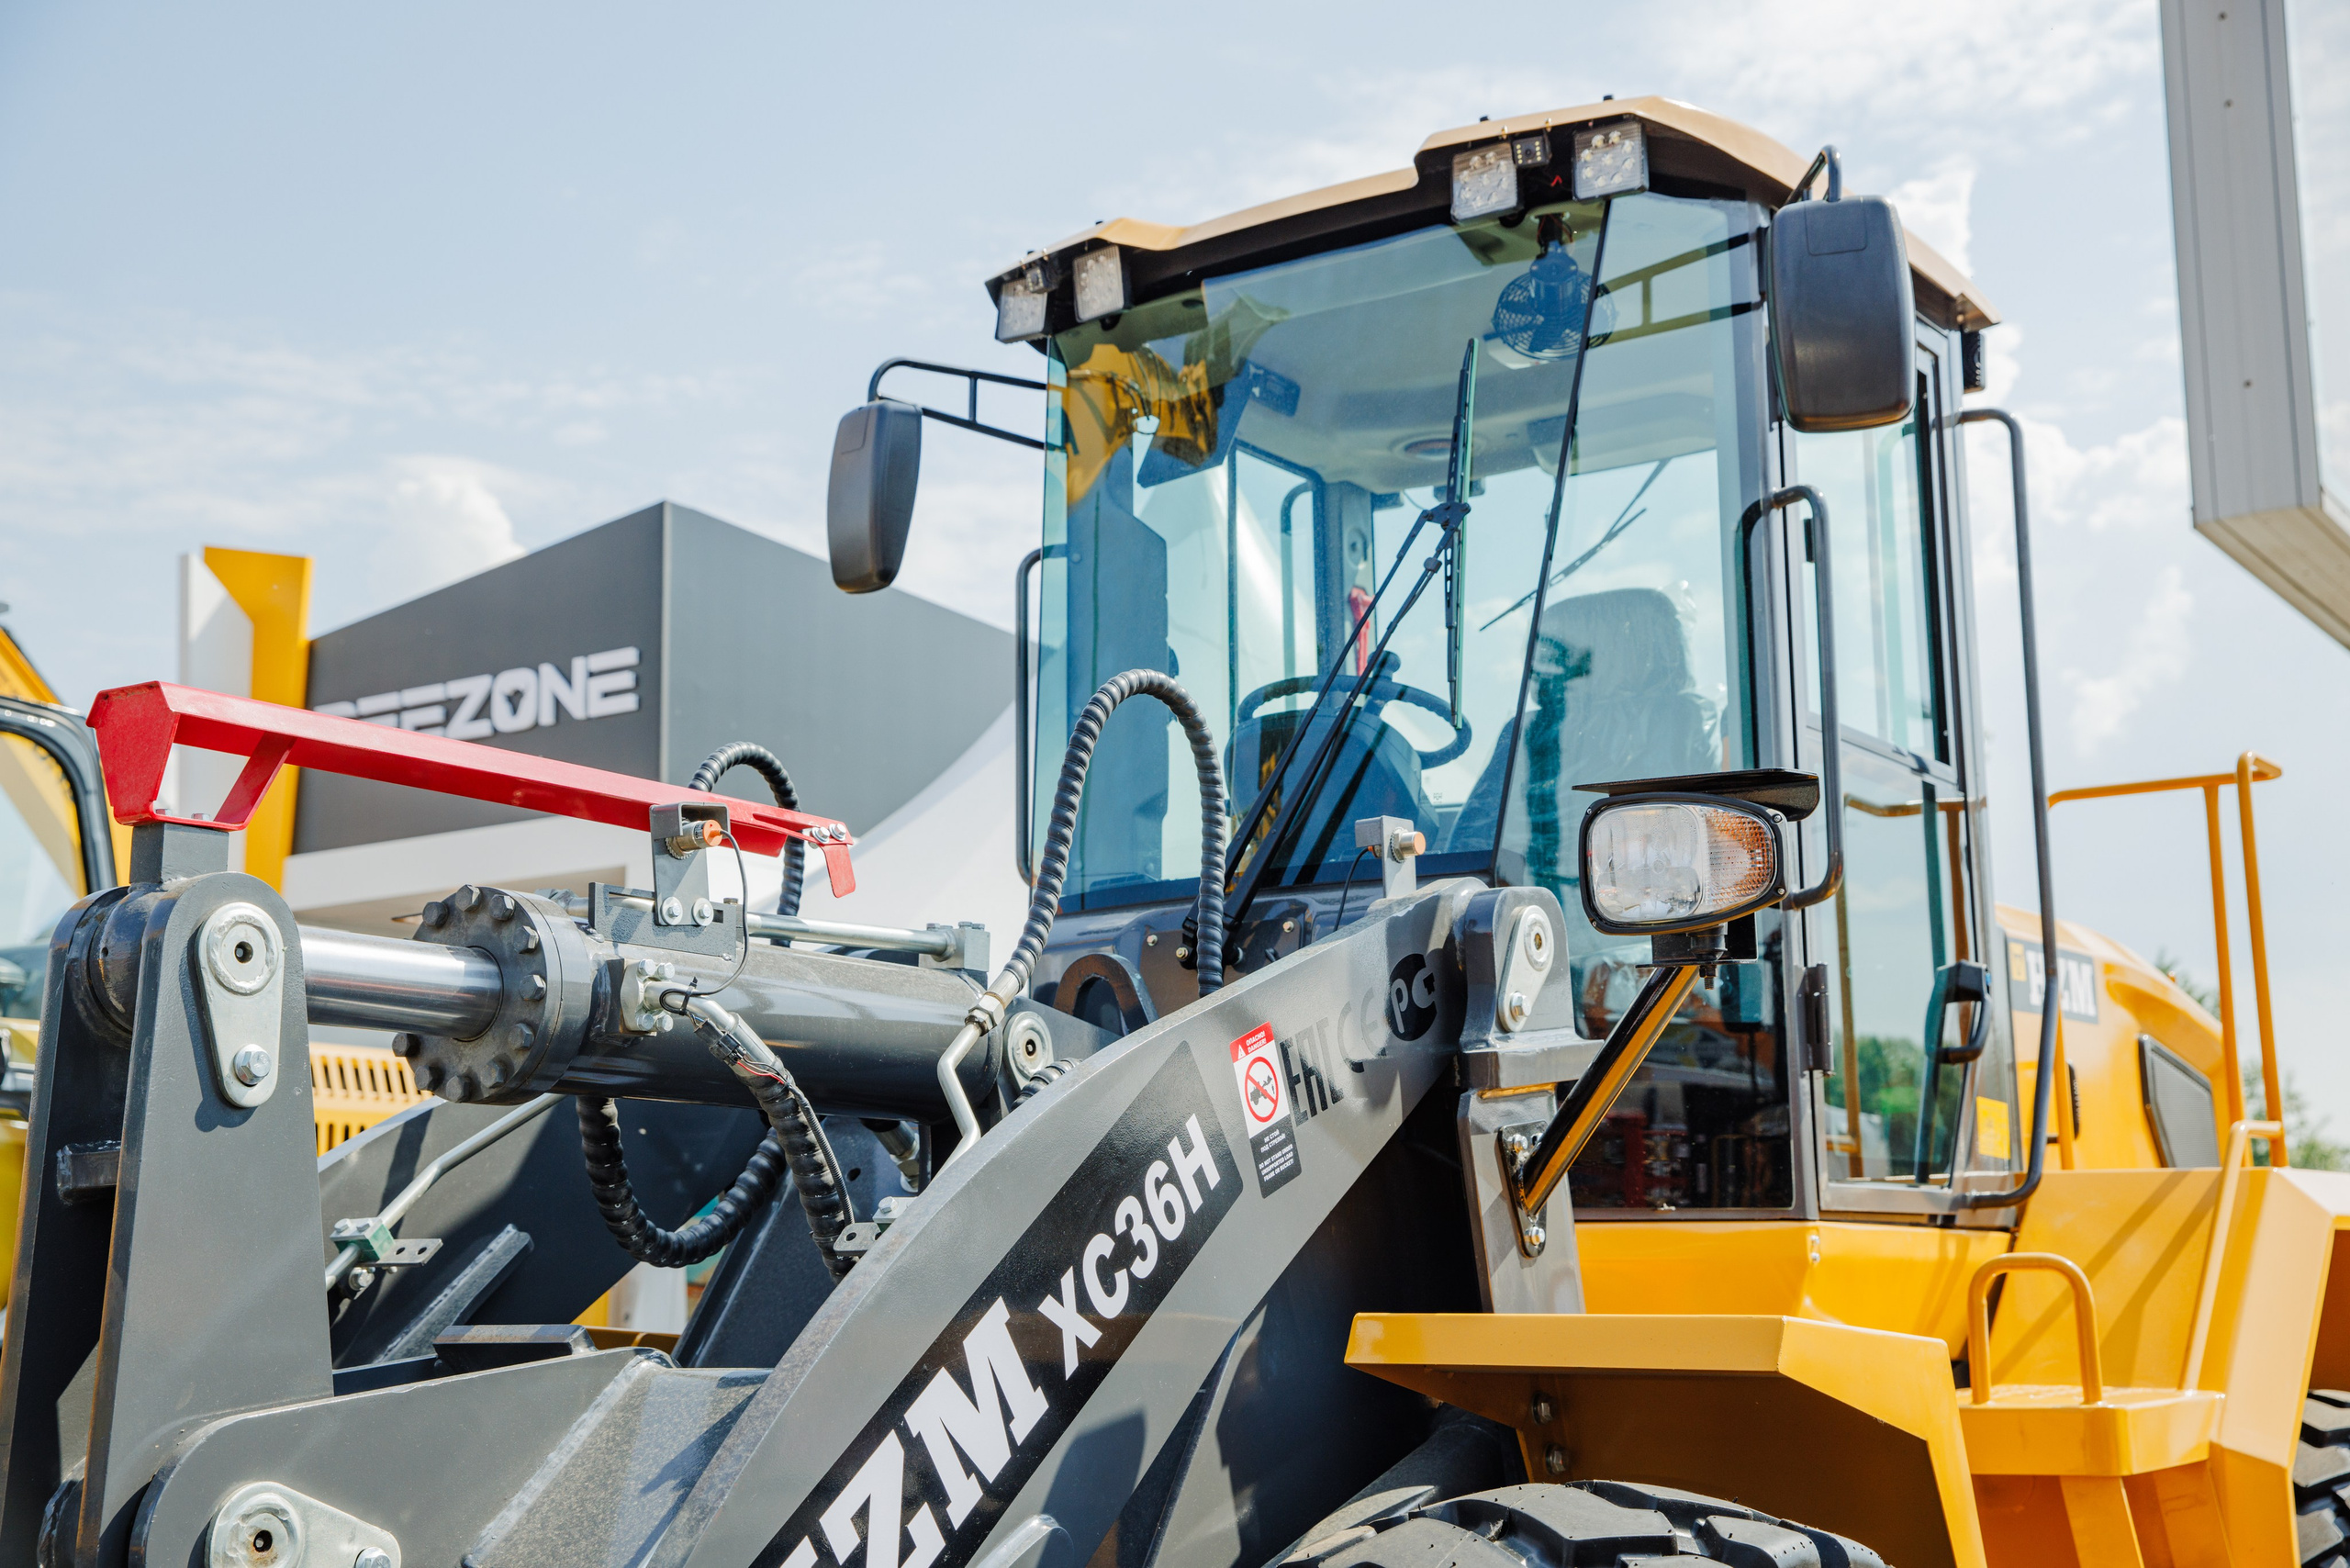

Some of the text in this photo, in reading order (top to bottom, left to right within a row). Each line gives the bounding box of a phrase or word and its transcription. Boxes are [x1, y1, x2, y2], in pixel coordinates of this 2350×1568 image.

[313, 645, 640, 741] EZONE
[1248, 1037, 1267, 1053] DANGER!
[779, 1113, 1221, 1568] ZM XC36H
